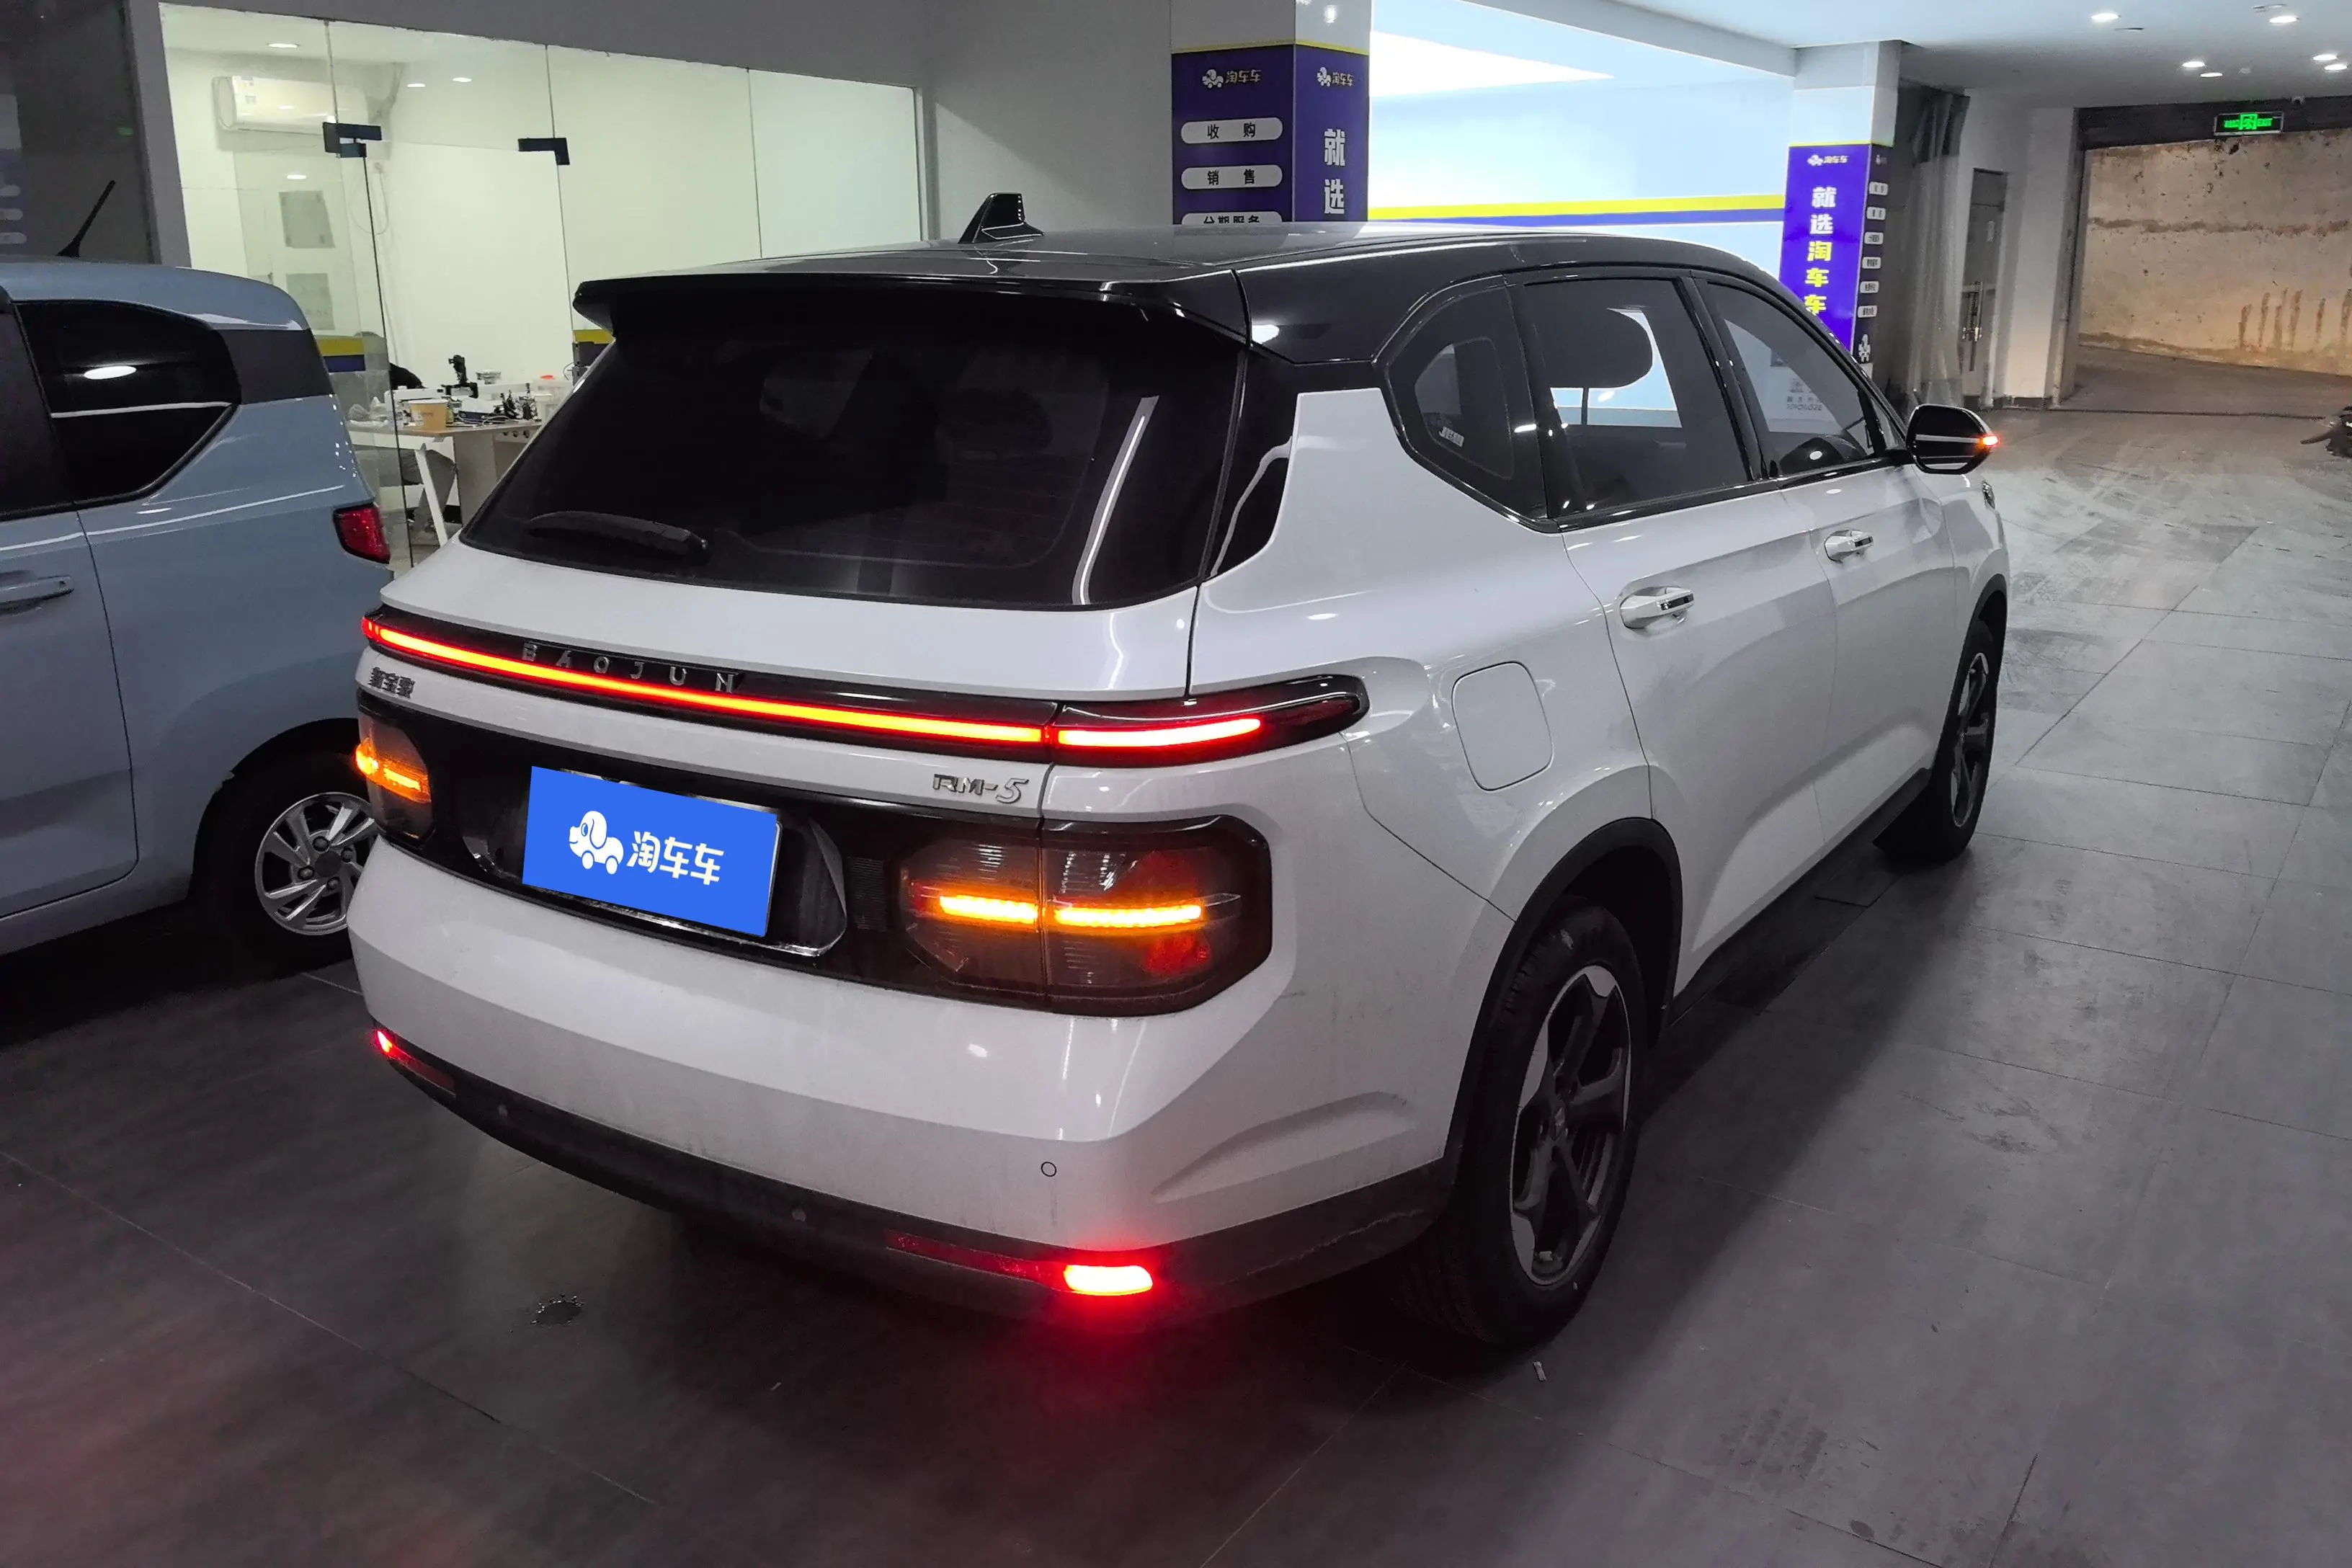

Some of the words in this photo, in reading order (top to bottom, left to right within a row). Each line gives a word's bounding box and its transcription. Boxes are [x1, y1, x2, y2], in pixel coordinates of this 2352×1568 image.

[1225, 69, 1262, 84] 淘车车
[1207, 122, 1256, 140] 收购
[1207, 169, 1255, 185] 销售
[1324, 128, 1346, 215] 就选
[1804, 187, 1837, 315] 就选淘车车
[522, 642, 735, 694] BAOJUN
[932, 773, 1029, 804] RM-5
